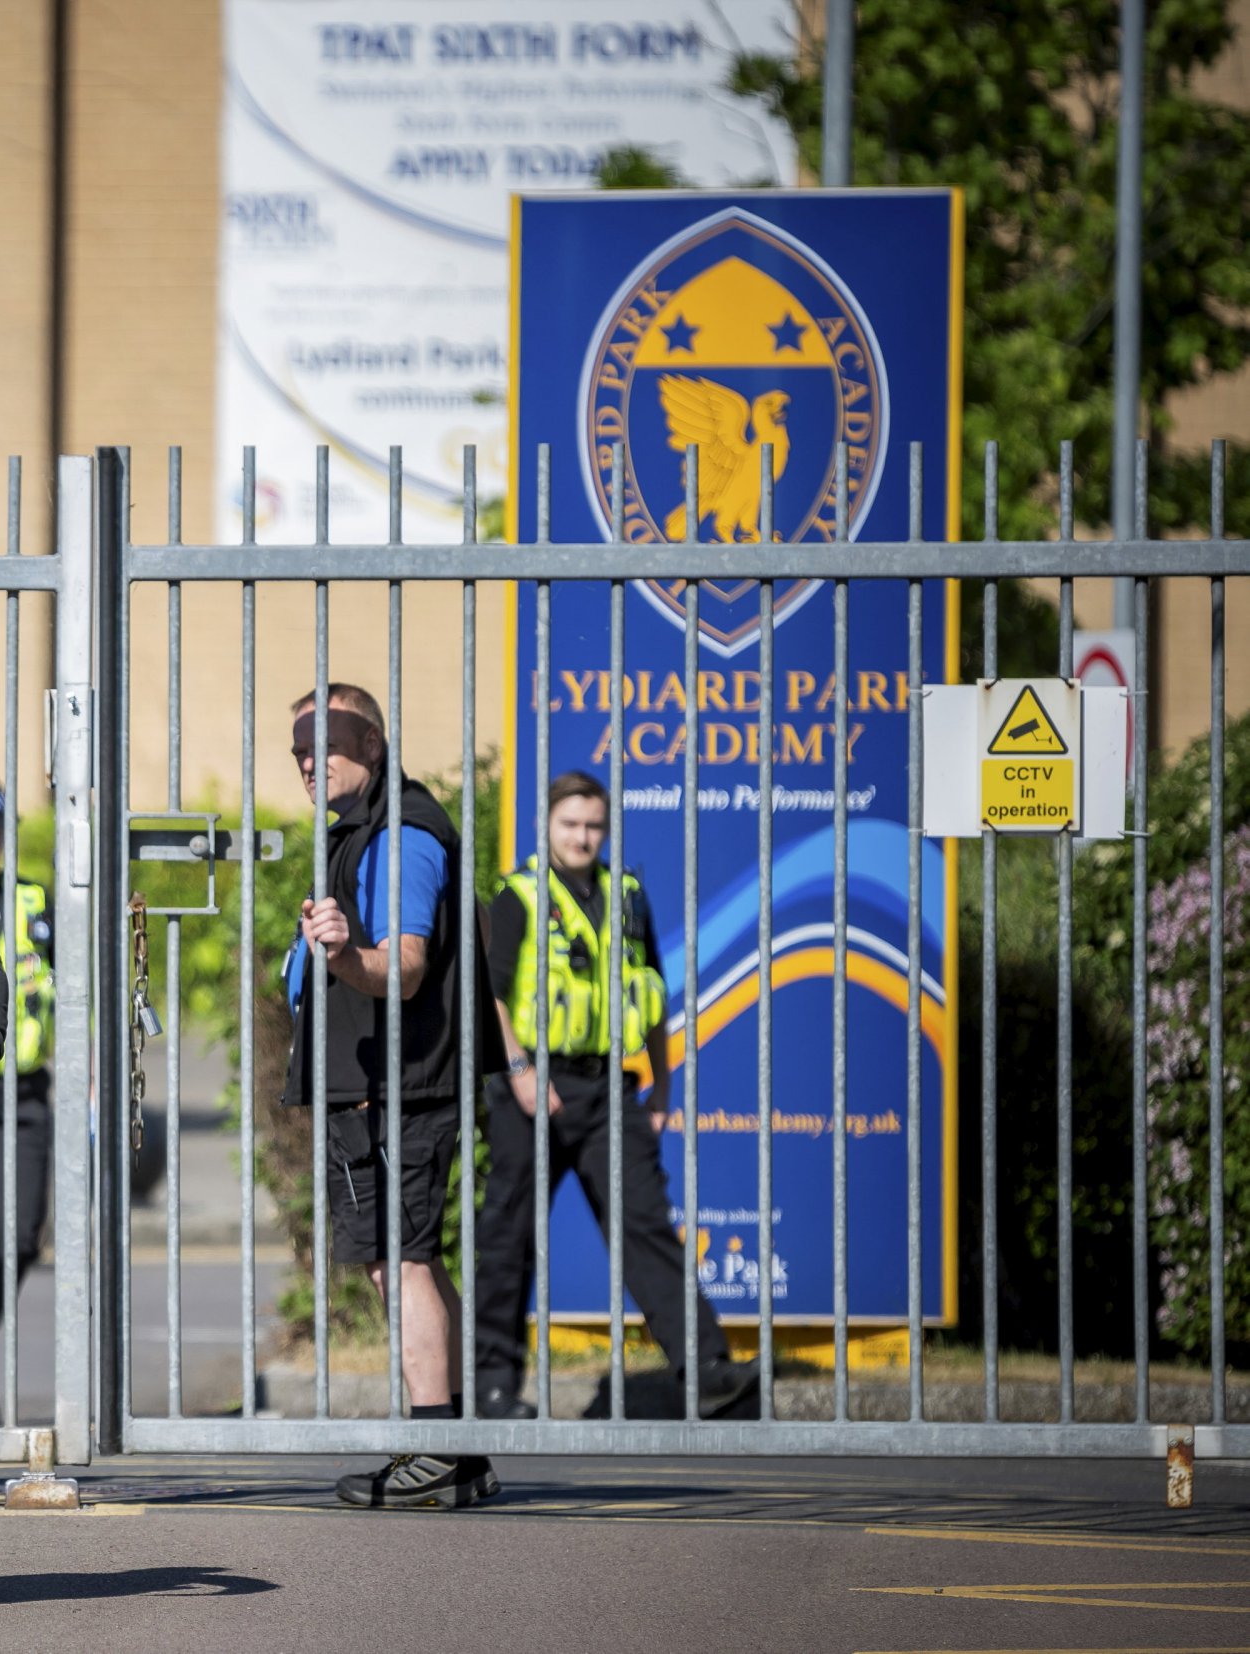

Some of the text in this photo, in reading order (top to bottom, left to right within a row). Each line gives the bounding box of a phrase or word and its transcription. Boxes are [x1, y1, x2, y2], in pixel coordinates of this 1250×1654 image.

[432, 23, 557, 63] SIXTH
[571, 23, 704, 64] FORM
[506, 146, 606, 178] TODA
[600, 276, 675, 388] PARK
[592, 721, 866, 765] ACADEMY
[1003, 766, 1054, 781] CCTV
[1021, 785, 1036, 799] in
[987, 803, 1069, 820] operation
[724, 1252, 789, 1283] Pak
